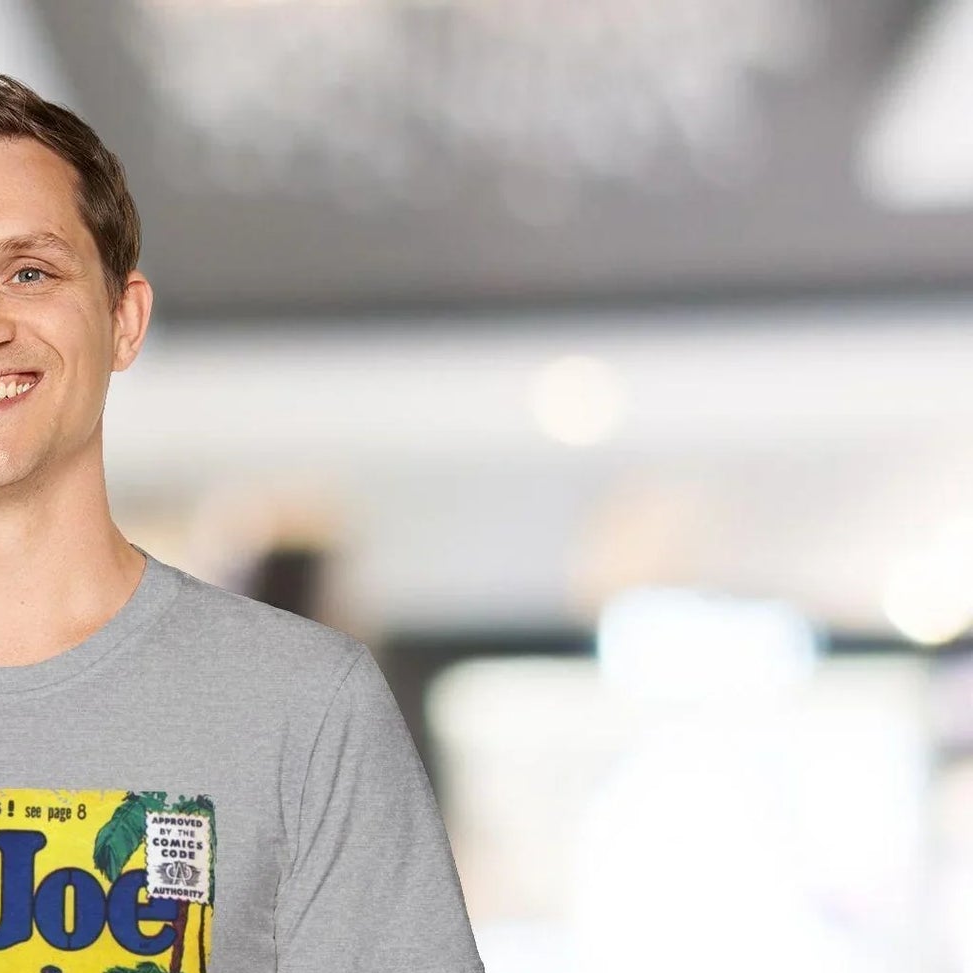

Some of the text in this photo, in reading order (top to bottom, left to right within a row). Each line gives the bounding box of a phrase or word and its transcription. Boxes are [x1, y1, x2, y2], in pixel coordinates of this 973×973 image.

[25, 806, 41, 818] see
[48, 807, 72, 822] page
[77, 803, 87, 820] 8
[152, 817, 203, 828] APPROVED
[159, 828, 195, 838] BY THE
[152, 838, 203, 850] COMICS
[161, 849, 196, 860] CODE
[153, 887, 204, 899] AUTHORITY
